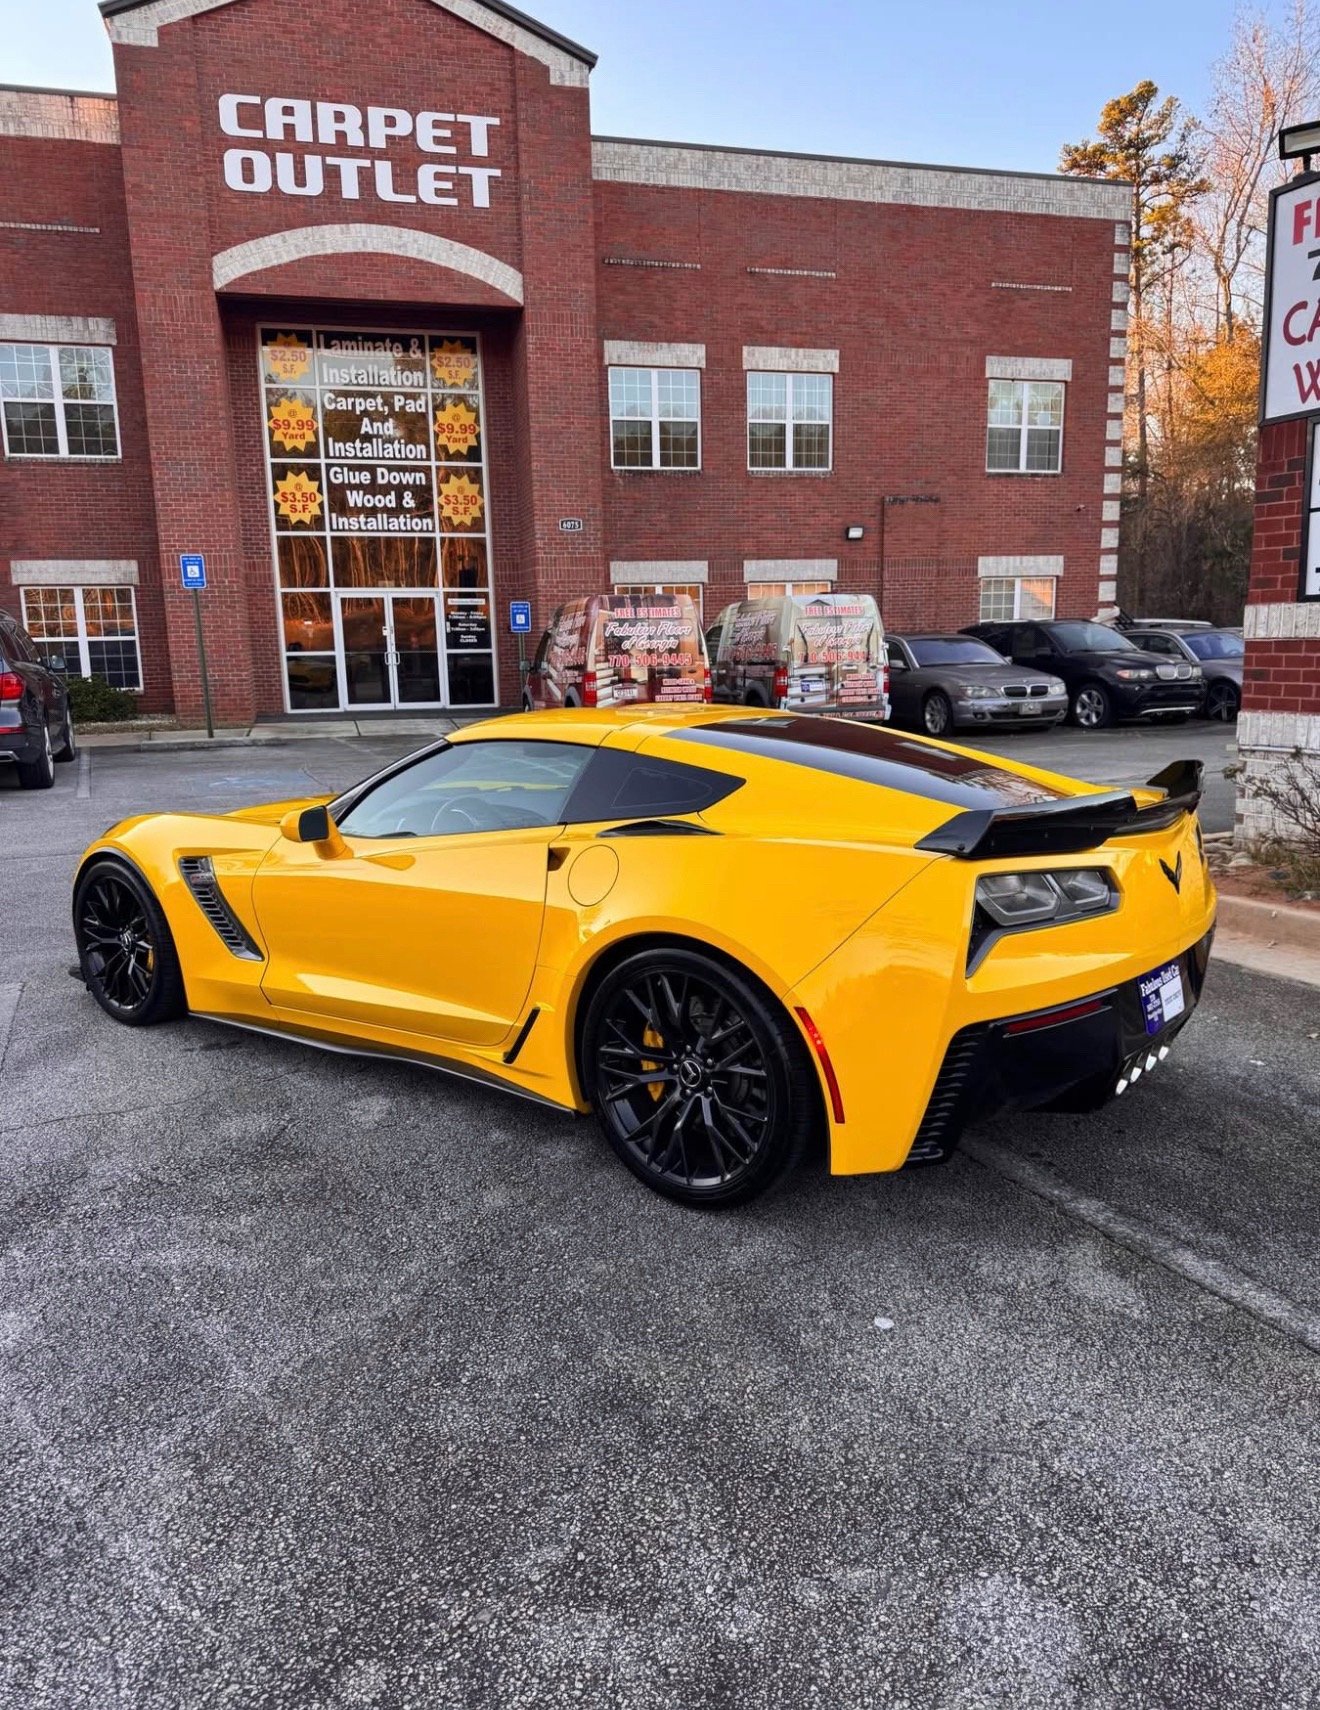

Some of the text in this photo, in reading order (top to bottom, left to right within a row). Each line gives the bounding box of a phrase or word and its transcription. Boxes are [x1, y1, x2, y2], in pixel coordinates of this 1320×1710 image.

[218, 93, 500, 157] CARPET
[223, 148, 501, 208] OUTLET
[1292, 197, 1320, 246] F
[319, 334, 422, 358] Laminate &
[270, 350, 307, 362] $2.50
[436, 356, 471, 368] $2.50
[322, 362, 424, 386] Installation
[323, 393, 426, 414] Carpet, Pad
[272, 419, 315, 431] $9.99
[360, 418, 393, 435] And
[437, 422, 477, 434] $9.99
[281, 431, 306, 440] Yard
[445, 435, 468, 444] Yard
[328, 437, 427, 459] Installation
[329, 467, 426, 485] Glue Down
[280, 491, 317, 503] $3.50
[346, 490, 415, 508] Wood &
[444, 495, 478, 506] $3.50
[289, 504, 312, 514] S.F.
[331, 513, 433, 531] Installation
[562, 520, 579, 529] 6075
[614, 606, 681, 618] FREE ESTIMATES
[605, 620, 692, 637] Fabulous Floors
[635, 635, 679, 652] Georgia
